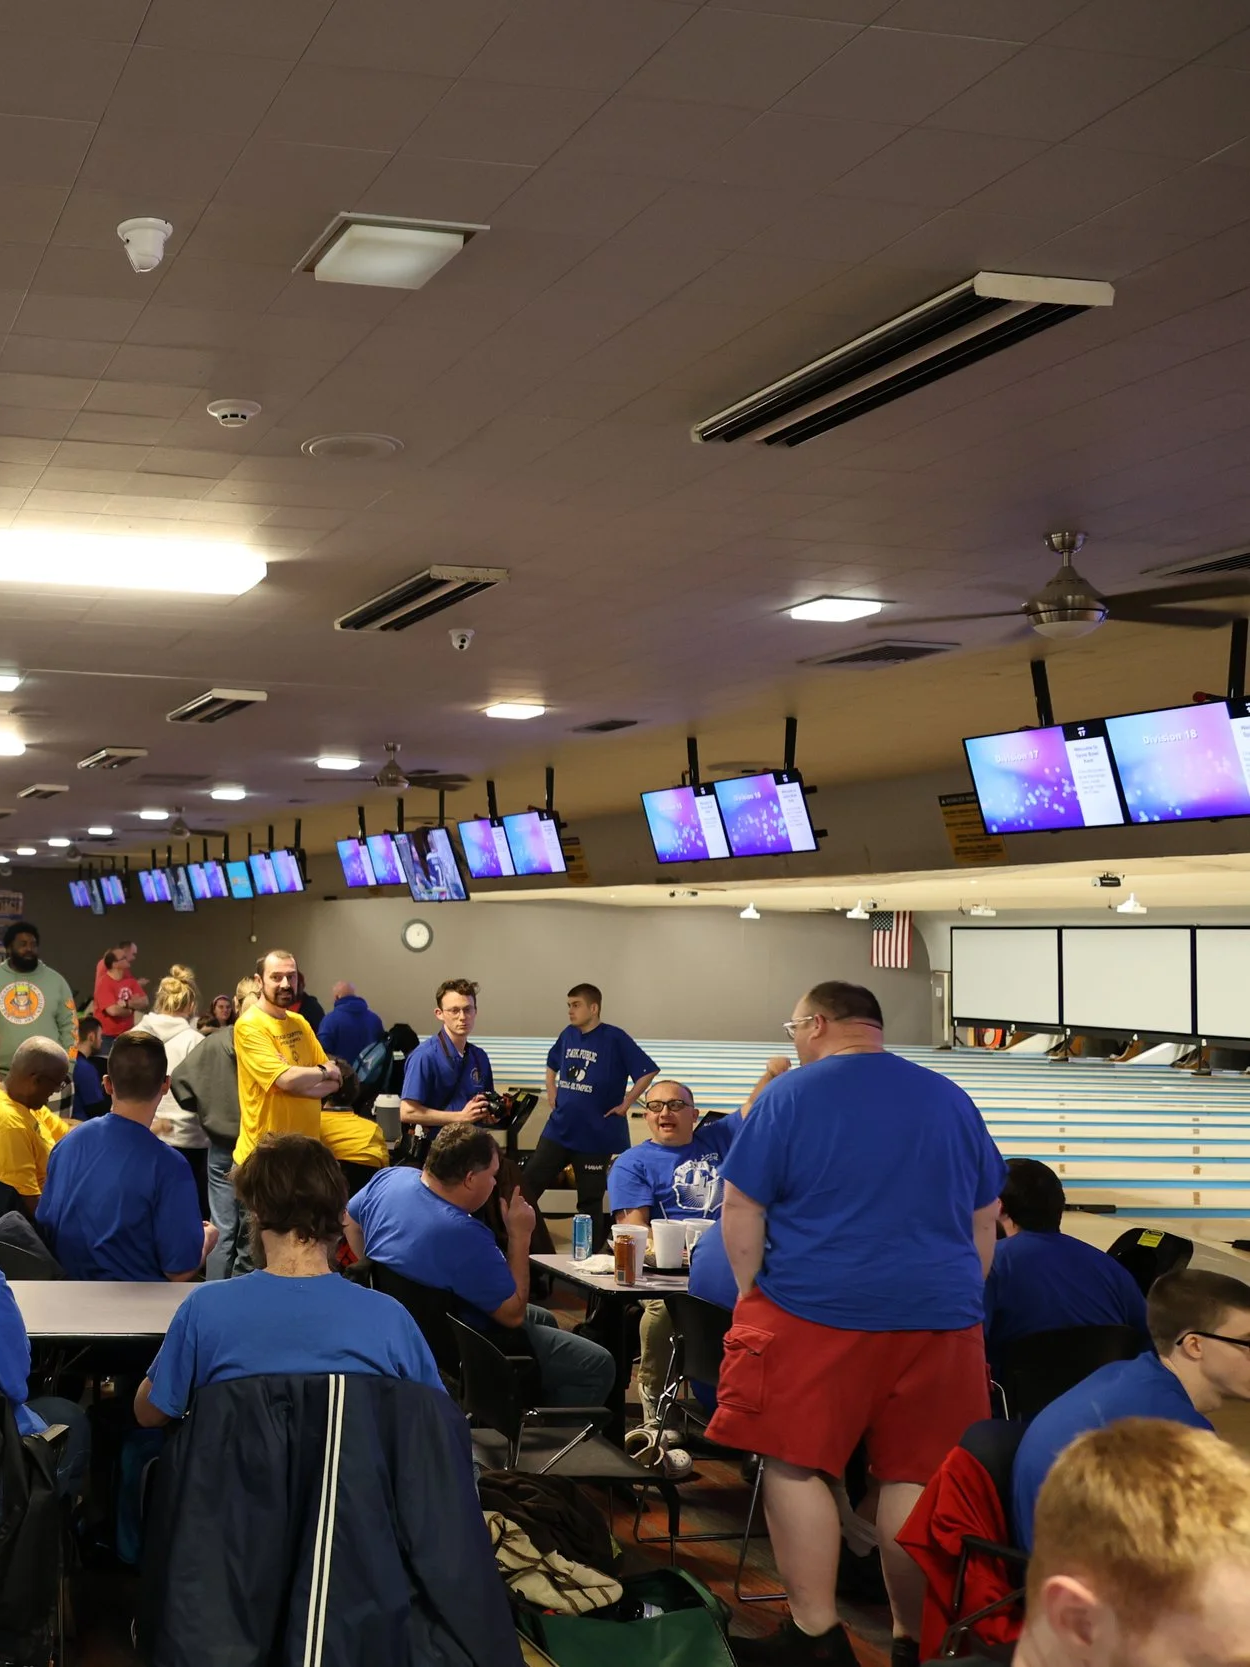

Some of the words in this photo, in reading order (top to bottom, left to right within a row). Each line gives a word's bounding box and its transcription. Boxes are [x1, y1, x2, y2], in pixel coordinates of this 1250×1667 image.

[1142, 732, 1183, 745] Division
[1184, 729, 1198, 740] 18
[994, 752, 1027, 764] Division
[1029, 749, 1040, 760] 17
